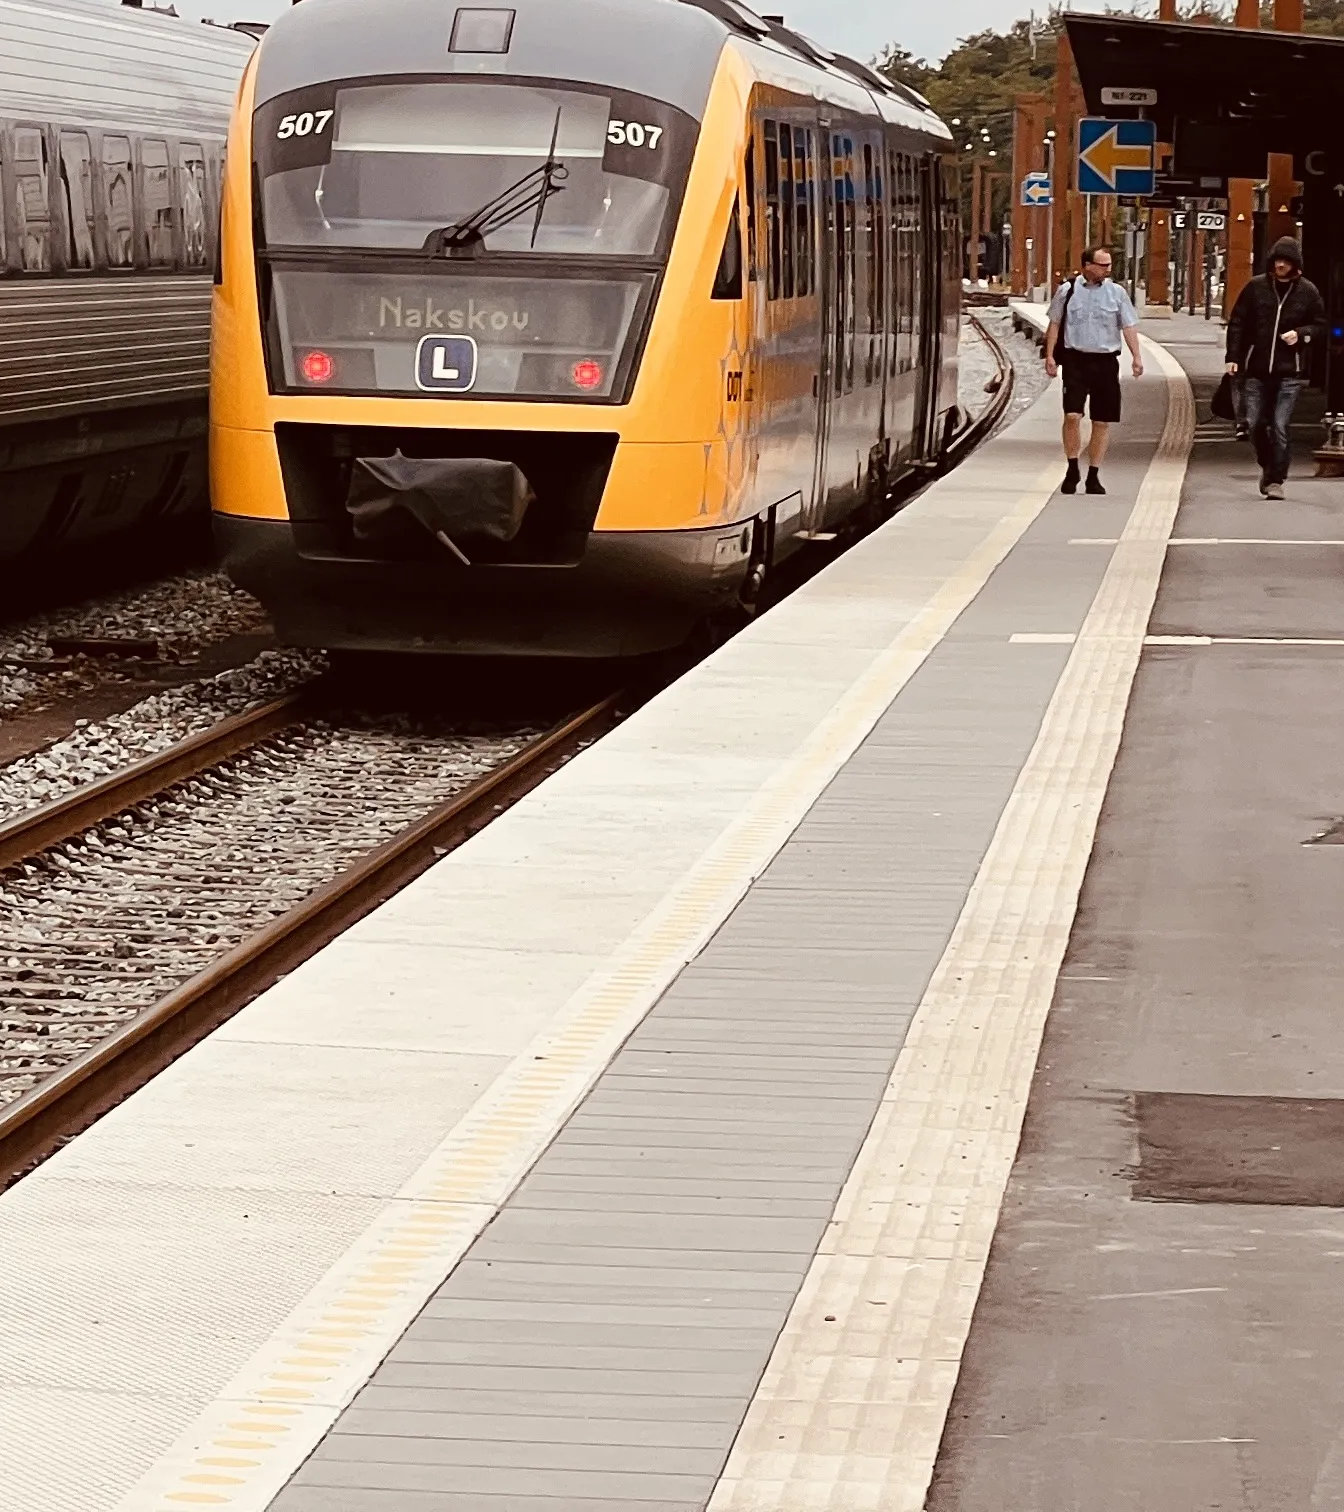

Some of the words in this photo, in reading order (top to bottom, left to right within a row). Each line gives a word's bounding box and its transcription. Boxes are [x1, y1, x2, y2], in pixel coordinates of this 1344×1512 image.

[276, 109, 334, 140] 507
[606, 120, 663, 150] 507
[1198, 214, 1224, 228] 270
[378, 296, 530, 332] Nakskov
[431, 346, 459, 380] L
